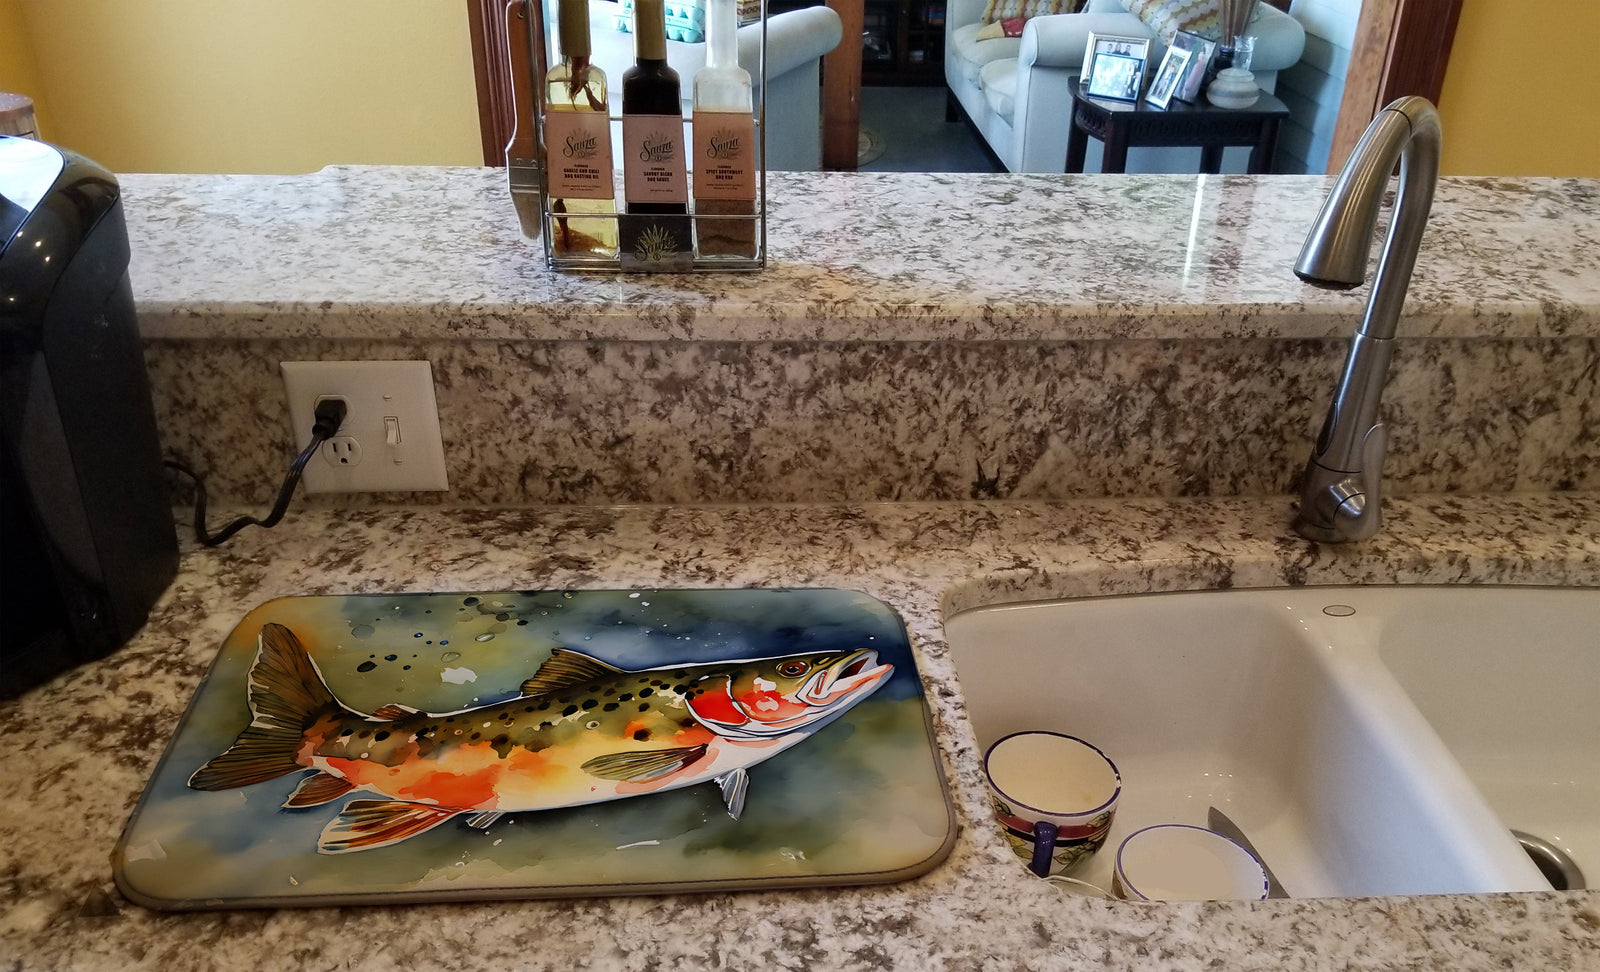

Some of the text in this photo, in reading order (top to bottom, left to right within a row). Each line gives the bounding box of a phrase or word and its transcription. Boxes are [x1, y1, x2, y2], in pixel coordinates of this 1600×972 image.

[563, 136, 597, 158] Sauza
[639, 140, 674, 162] Sauza
[706, 137, 741, 158] Sauza
